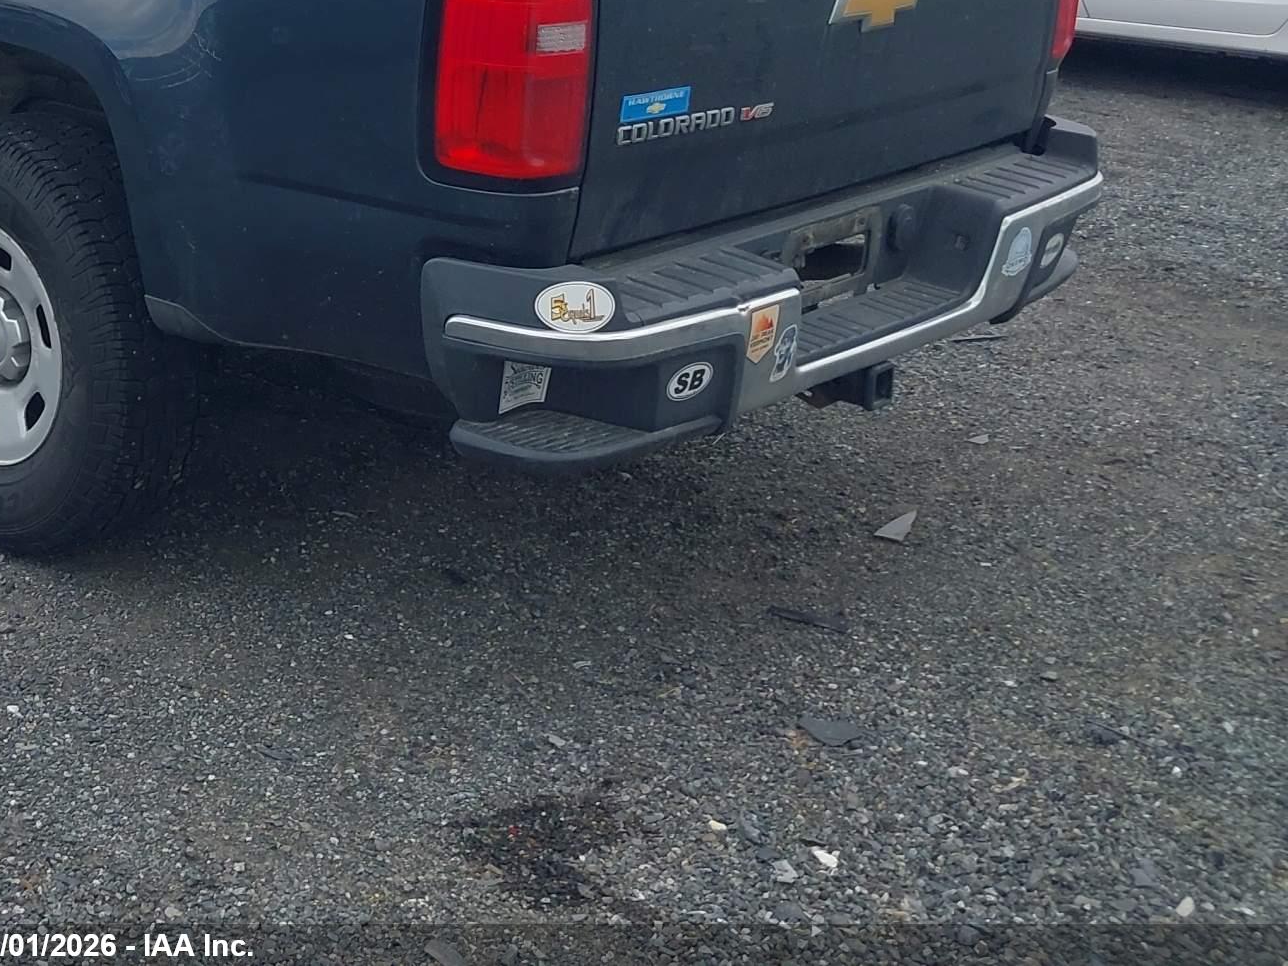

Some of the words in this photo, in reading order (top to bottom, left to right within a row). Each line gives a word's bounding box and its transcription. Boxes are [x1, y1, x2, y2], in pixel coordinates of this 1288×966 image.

[616, 107, 735, 146] COLORADO
[740, 101, 775, 122] V6
[674, 368, 707, 395] SB
